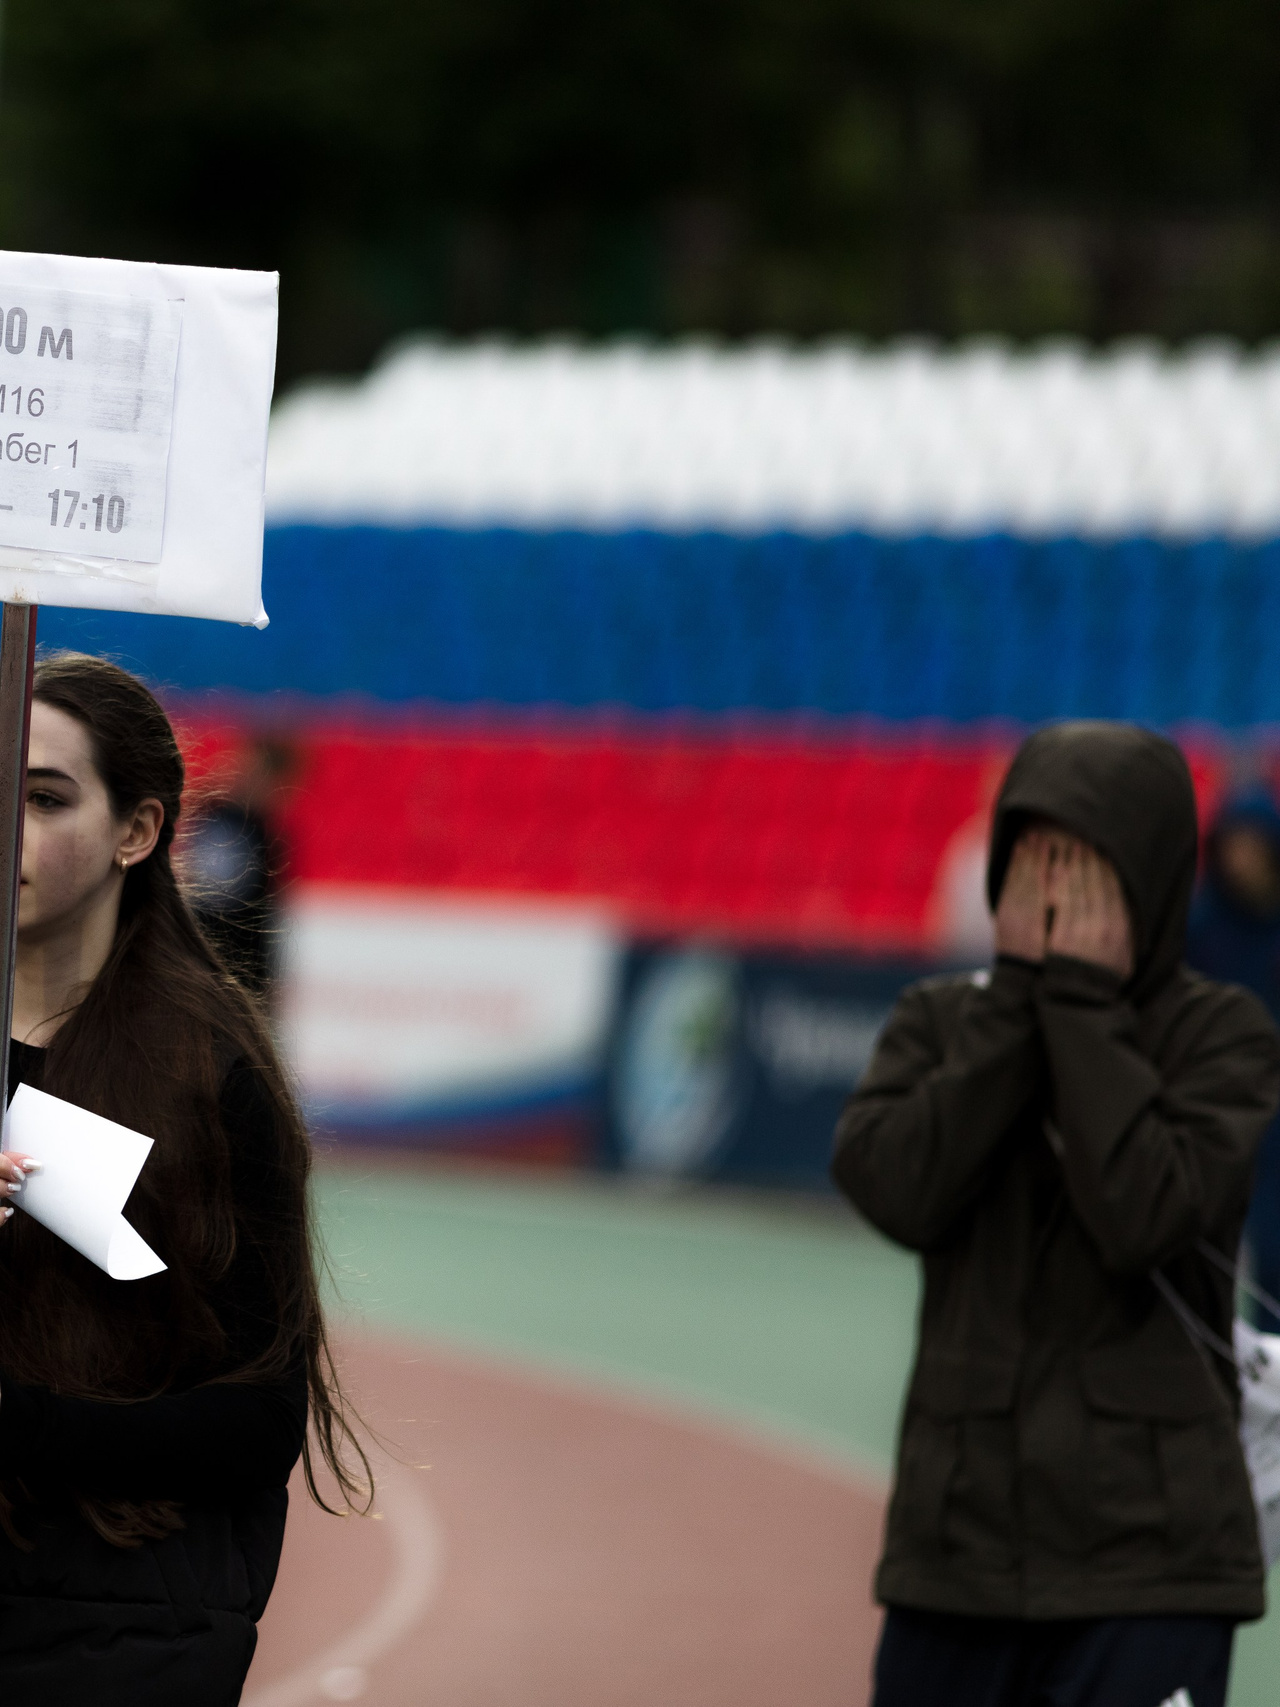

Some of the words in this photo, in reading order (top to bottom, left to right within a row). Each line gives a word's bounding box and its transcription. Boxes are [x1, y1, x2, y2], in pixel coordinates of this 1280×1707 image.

[37, 325, 74, 361] м
[67, 439, 80, 469] 1
[47, 489, 125, 533] 17:10
